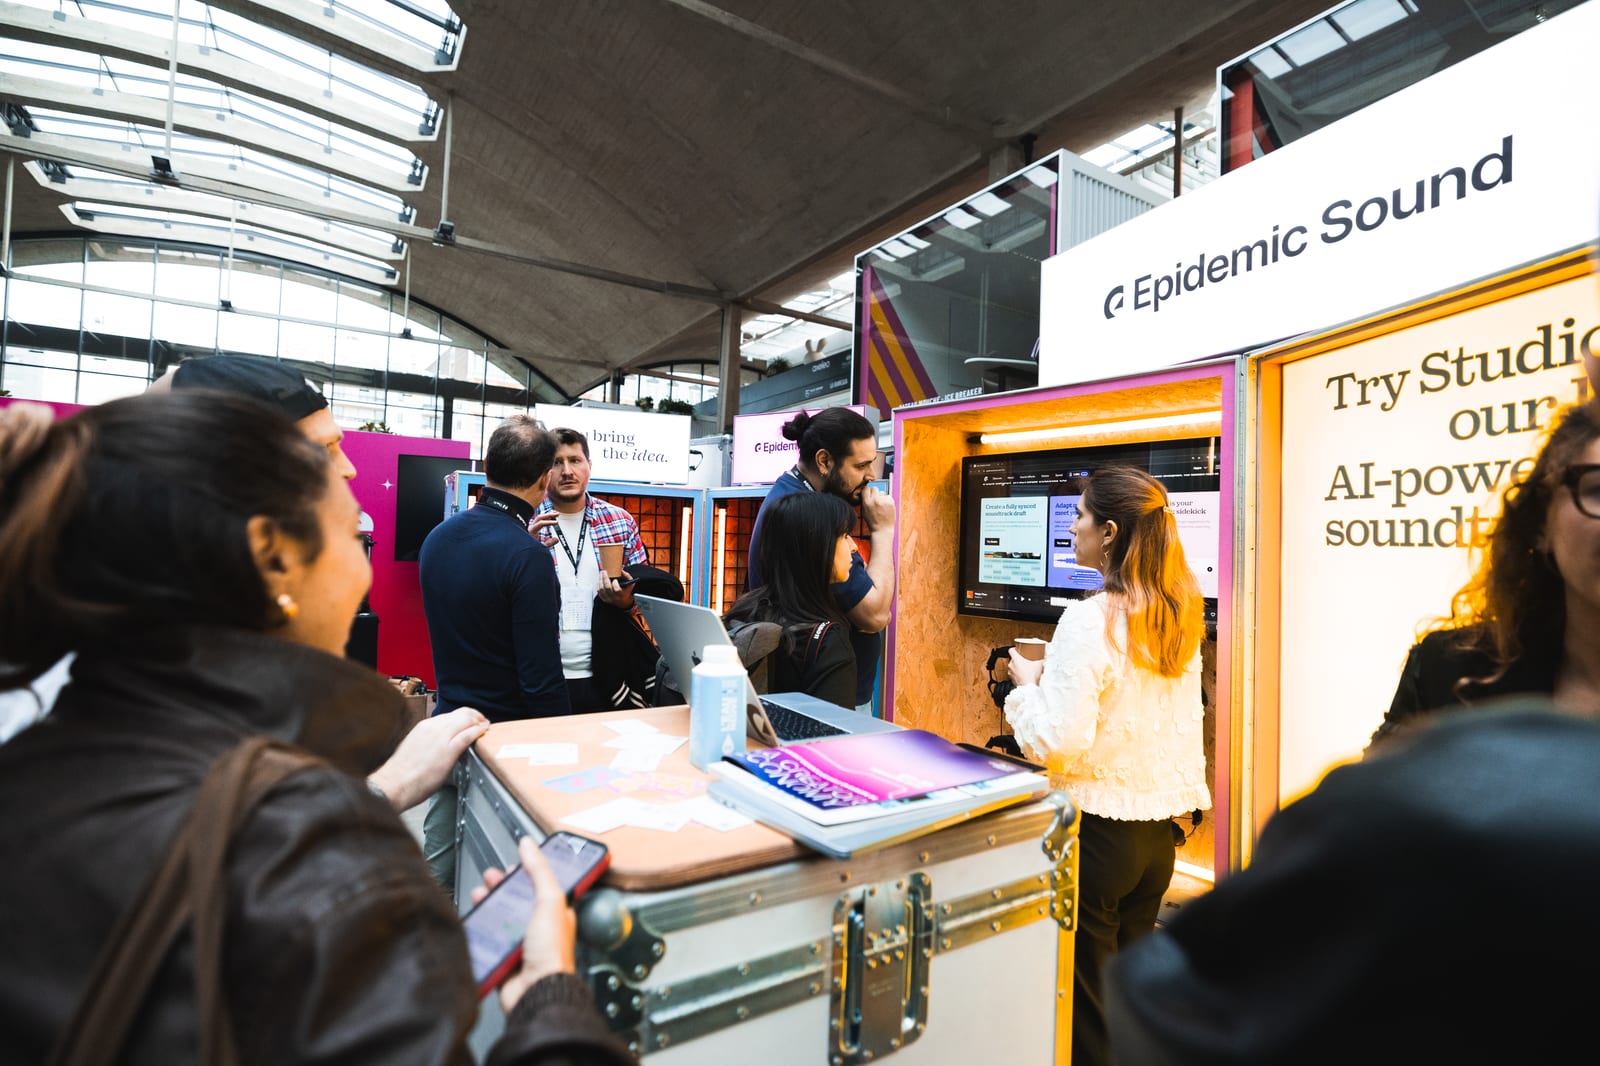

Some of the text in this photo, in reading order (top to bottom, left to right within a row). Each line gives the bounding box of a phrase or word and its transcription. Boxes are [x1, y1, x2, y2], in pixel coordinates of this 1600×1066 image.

[1133, 134, 1514, 312] Epidemic Sound
[955, 387, 983, 400] BREAKER
[1325, 370, 1411, 412] Try
[1449, 395, 1558, 441] our
[593, 429, 635, 447] bring
[603, 447, 668, 463] the idea.
[1006, 503, 1017, 511] fully
